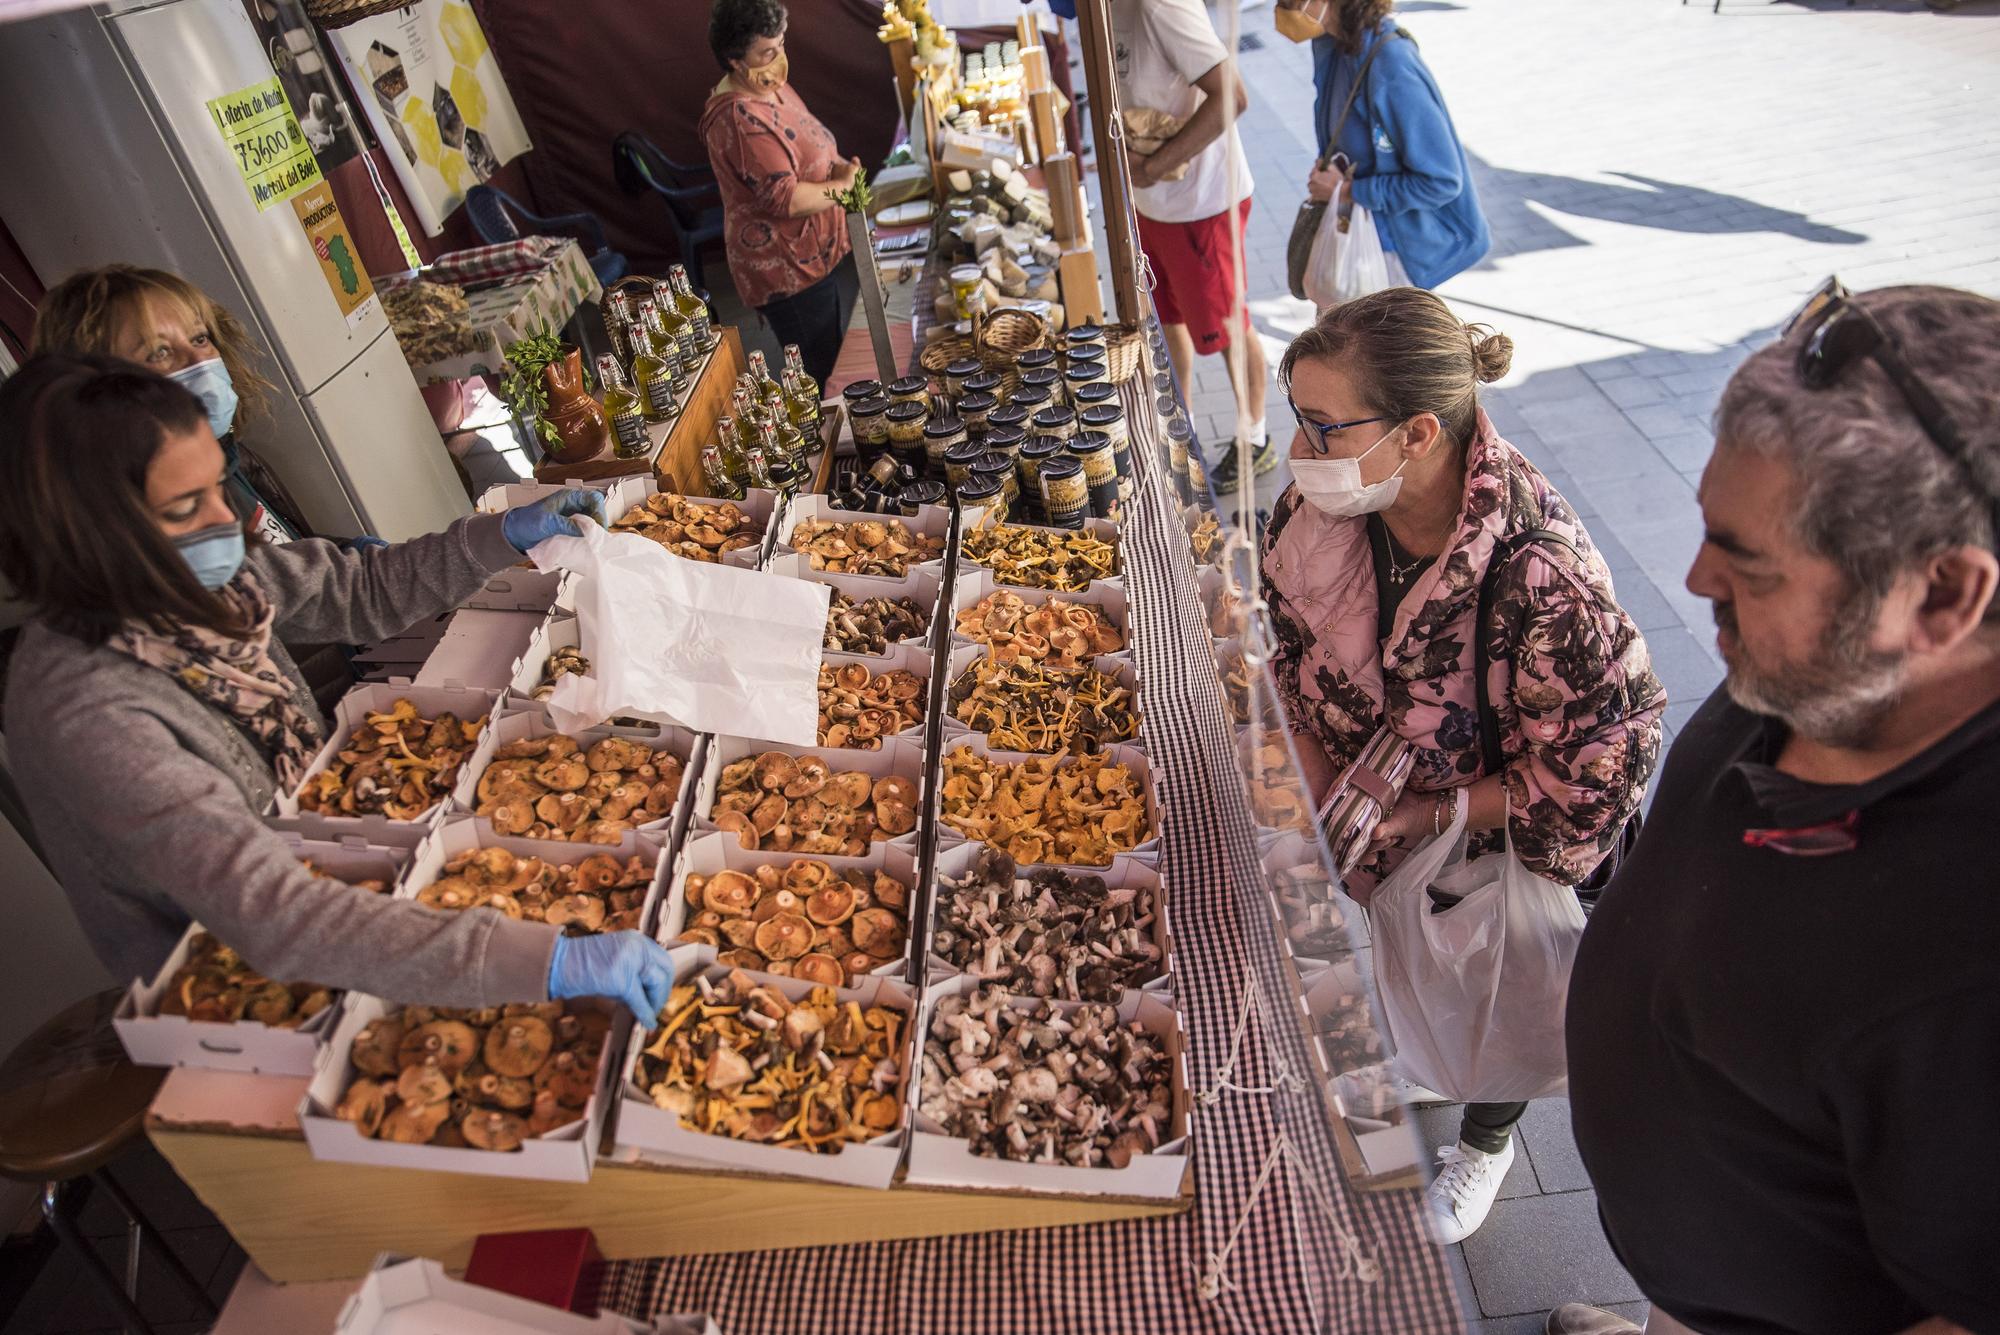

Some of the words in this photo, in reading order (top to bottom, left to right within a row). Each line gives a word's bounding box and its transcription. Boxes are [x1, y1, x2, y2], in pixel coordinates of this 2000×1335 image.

[252, 96, 265, 114] de
[261, 85, 285, 110] Nadal
[233, 131, 288, 171] 75600
[252, 173, 287, 204] Mercat
[285, 165, 301, 188] del
[297, 157, 318, 180] Bolet
[303, 201, 337, 230] PRODUCTORS
